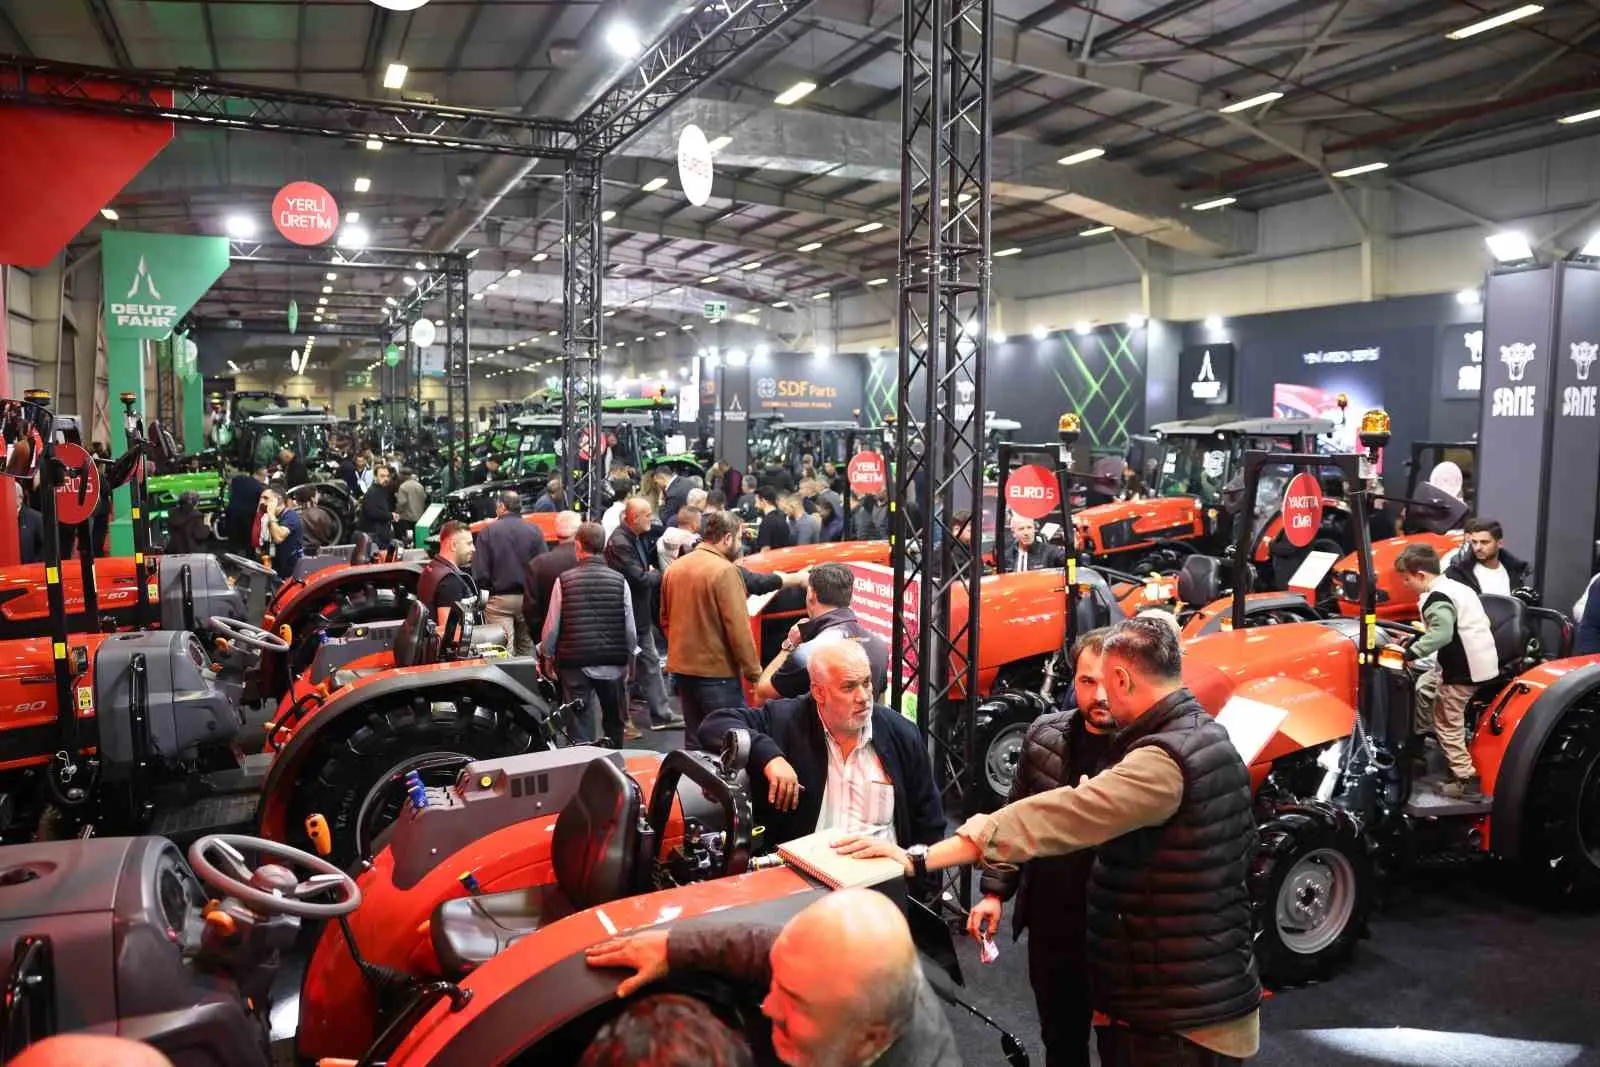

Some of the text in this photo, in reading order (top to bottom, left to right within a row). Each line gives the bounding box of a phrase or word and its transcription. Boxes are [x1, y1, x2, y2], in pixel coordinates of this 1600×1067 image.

[285, 196, 326, 213] YERLİ
[280, 210, 332, 230] ÜRETİM
[110, 303, 177, 316] DEUTZ
[117, 315, 171, 328] FAHR
[777, 380, 838, 399] SDF Parts
[1492, 386, 1536, 417] SAME
[1562, 386, 1598, 417] SAME
[1010, 485, 1044, 499] EURO
